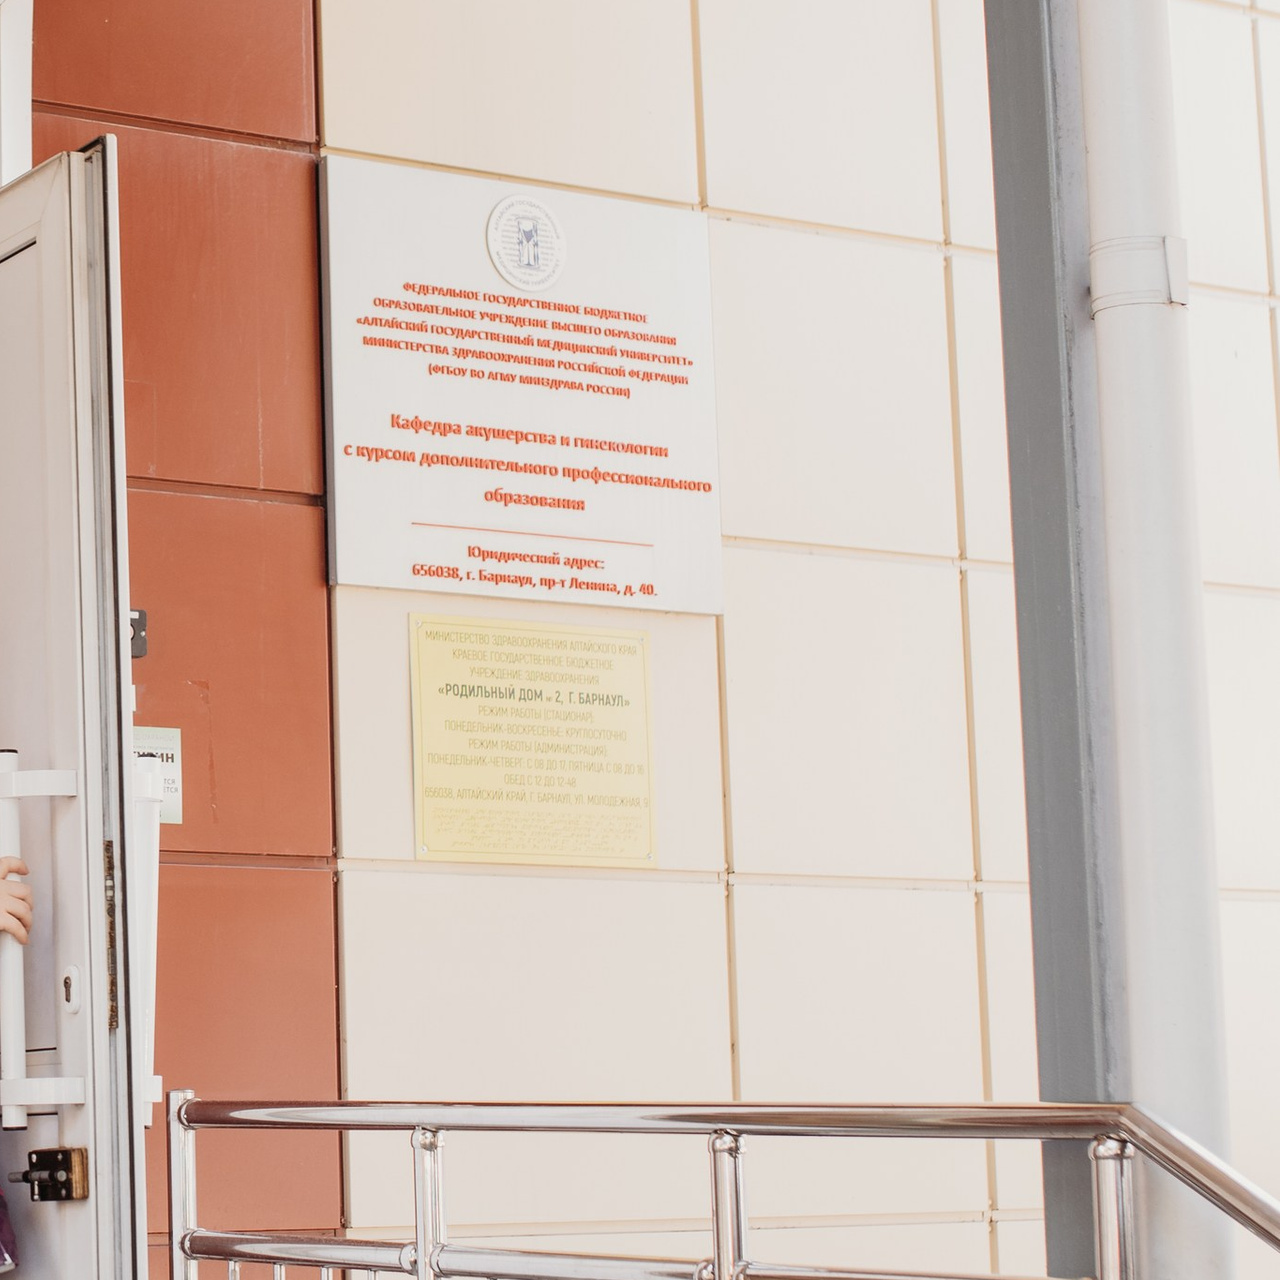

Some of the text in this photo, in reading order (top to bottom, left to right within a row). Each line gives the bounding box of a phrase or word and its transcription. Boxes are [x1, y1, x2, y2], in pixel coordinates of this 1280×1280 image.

[403, 282, 648, 323] ФЕДЕРАЛЬНОЕ ГОСУДАРСТВЕННОЕ БЮДЖЕТНОЕ
[373, 298, 676, 345] ОБРАЗОВАТЕЛЬНОЕ УЧРЕЖДЕНИЕ ВЫСШЕГО ОБРАЗОВАНИЯ
[356, 317, 693, 366] «АЛТАЙСКИЙ ГОСУДАРСТВЕННЫЙ МЕДИЦИНСКИЙ УНИВЕРСИТЕТ»
[363, 336, 688, 385] МИНИСТЕРСТВА ЗДРАВООХРАНЕНИЯ РОССИЙСКОЙ ФЕДЕРАЦИИ
[428, 363, 630, 399] (ФГБОУ ВО АГМУ МИНЗДРАВА РОССИИ)
[391, 414, 669, 458] Кафедра акушерства и гинекологии
[344, 444, 712, 493] с курсом дополнительного профессионального
[484, 488, 585, 511] образования
[467, 546, 605, 570] Юридический адрес:
[412, 564, 658, 596] 656038, г. Барнаул, пр-т Ленина, д. 40.
[425, 630, 637, 655] МИНИСТЕРСТВО ЗДРАВООХРАНЕНИЯ АЛТАЙСКОГО КРАЯ
[452, 649, 614, 671] КРАЕВОЕ ГОСУДАРСТВЕННОЕ БЮДЖЕТНОЕ
[469, 666, 599, 685] УЧРЕЖДЕНИЕ ЗДРАВООХРАНЕНИЯ
[438, 683, 515, 700] «РОДИЛЬНЫЙ
[519, 688, 543, 702] ДОМ
[555, 690, 563, 706] 2,
[569, 691, 576, 704] Г.
[578, 692, 630, 707] БАРНАУЛ»
[478, 705, 508, 717] РЕЖИМ
[510, 707, 541, 720] РАБОТЫ
[468, 739, 498, 750] РЕЖИМ
[501, 740, 532, 752] РАБОТЫ
[565, 727, 627, 741] КРУГЛОСУТОЧНО
[527, 758, 532, 768] С
[534, 759, 543, 770] 08
[546, 759, 557, 772] ДО
[569, 761, 605, 774] ПЯТНИЦА
[606, 763, 611, 773] С
[613, 763, 623, 774] 08
[624, 764, 635, 776] ДО
[504, 773, 576, 788] ОБЕД С 12 ДО 12-48
[425, 787, 453, 799] 656038,
[457, 787, 503, 802] АЛТАЙСКИЙ
[505, 790, 528, 804] КРАЙ,
[530, 791, 535, 802] Г.
[537, 792, 572, 805] БАРНАУЛ,
[574, 793, 585, 805] УЛ.
[587, 795, 643, 808] МОЛОДЕЖНАЯ,
